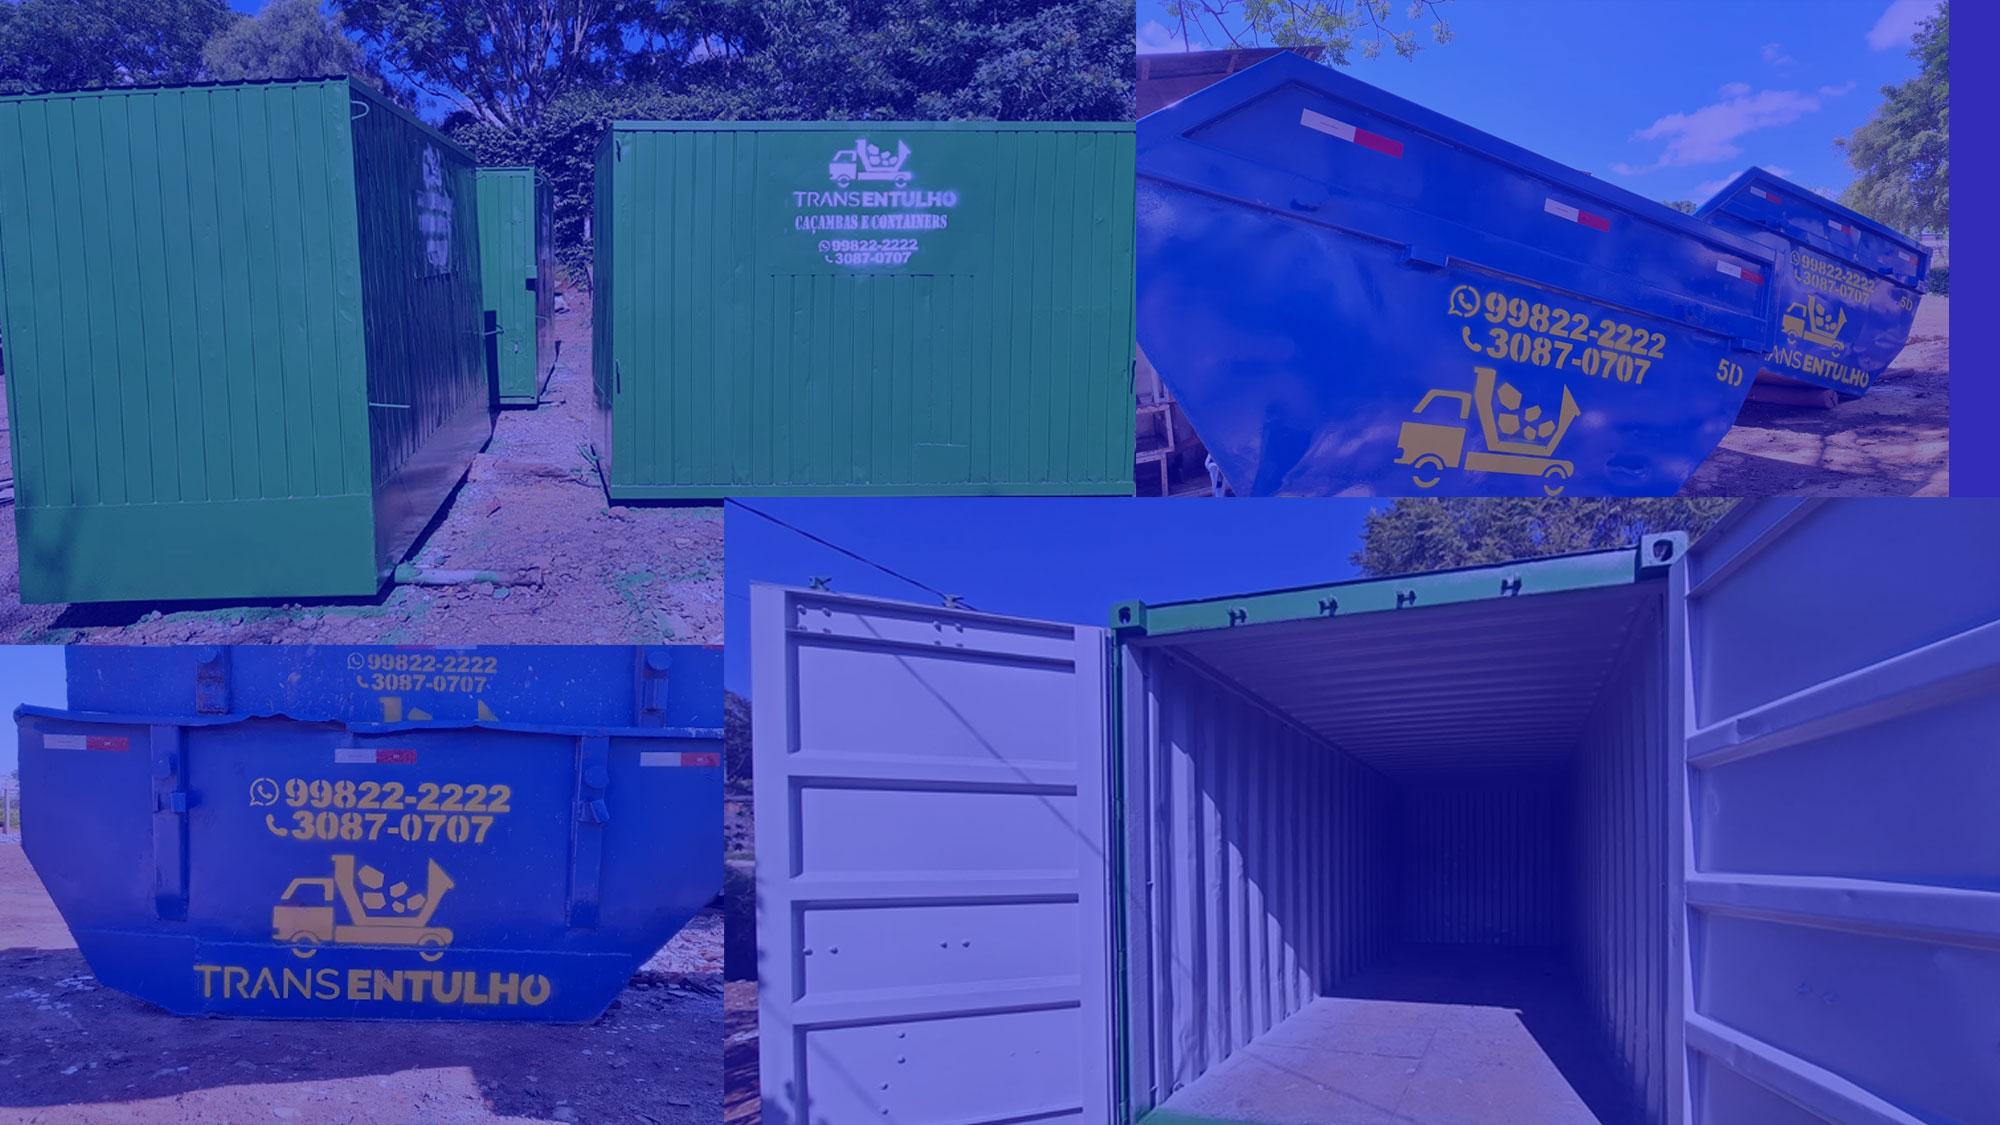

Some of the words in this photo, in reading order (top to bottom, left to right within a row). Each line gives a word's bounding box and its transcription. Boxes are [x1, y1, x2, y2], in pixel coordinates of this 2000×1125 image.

[795, 215, 858, 234] CAÇAMBAS
[861, 215, 869, 229] E
[871, 214, 948, 229] CONTAINERS
[832, 239, 919, 252] 99822-2222
[835, 252, 912, 264] 3087-0707
[1801, 254, 1876, 293] 99822-2222
[1803, 271, 1870, 305] 3087-0707
[1484, 292, 1666, 359] 99822-2222
[1486, 327, 1651, 384] 3087-0707
[1716, 358, 1743, 386] 5D
[1764, 344, 1803, 369] ANS
[1802, 354, 1869, 388] ENTULHO
[367, 653, 498, 674] 99822-2222
[371, 674, 487, 693] 3087-0707
[285, 778, 511, 813] 99822-2222
[291, 811, 494, 843] 3087-0707
[193, 965, 340, 1000] TRANS
[347, 969, 551, 1006] ENTULHO
